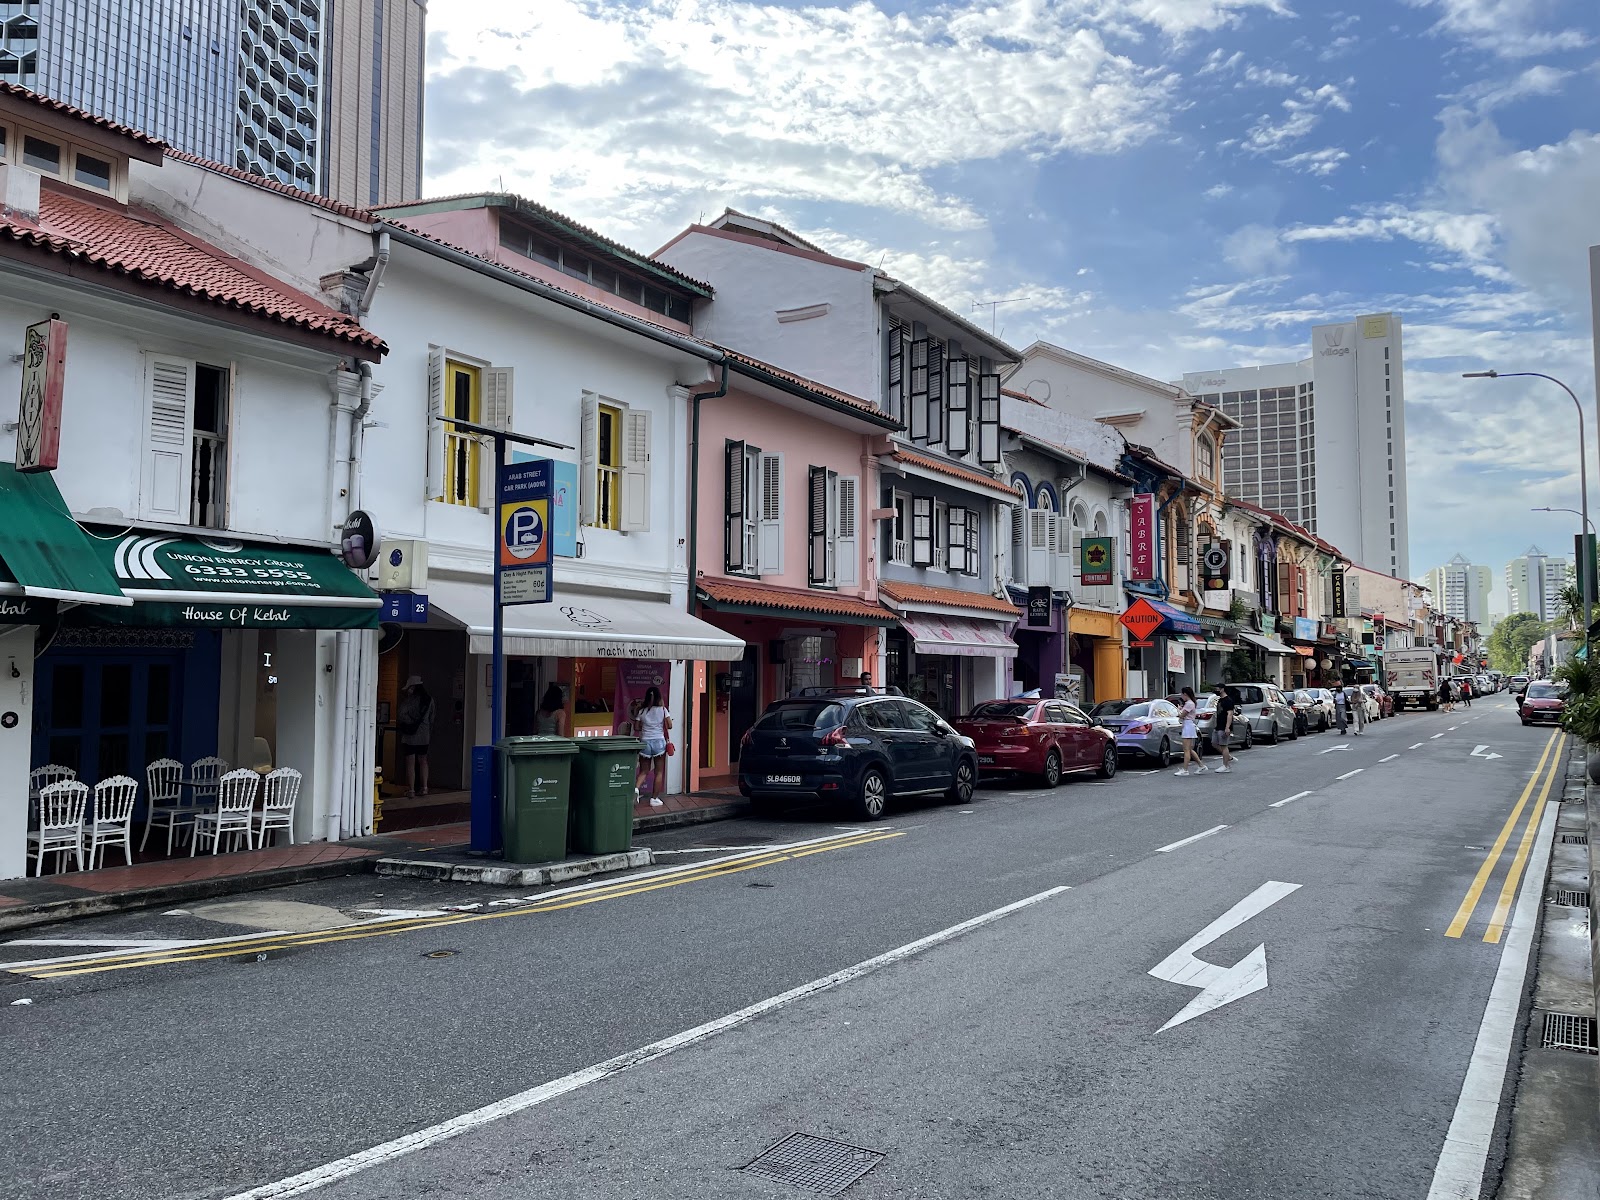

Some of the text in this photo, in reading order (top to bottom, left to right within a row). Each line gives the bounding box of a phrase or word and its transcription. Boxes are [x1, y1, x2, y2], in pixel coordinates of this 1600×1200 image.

[1320, 347, 1350, 356] village
[508, 470, 541, 481] ARAB STREET
[513, 511, 539, 545] P
[1137, 505, 1147, 564] SABRE
[166, 552, 304, 568] UNION ENERGY GROUP
[185, 565, 311, 580] 6333 5555
[193, 577, 321, 588] www.unionenergy.com.sg
[415, 604, 425, 612] 25
[182, 606, 292, 626] House Of Kebab
[1125, 615, 1158, 624] CAUTION
[597, 644, 655, 657] machi machi
